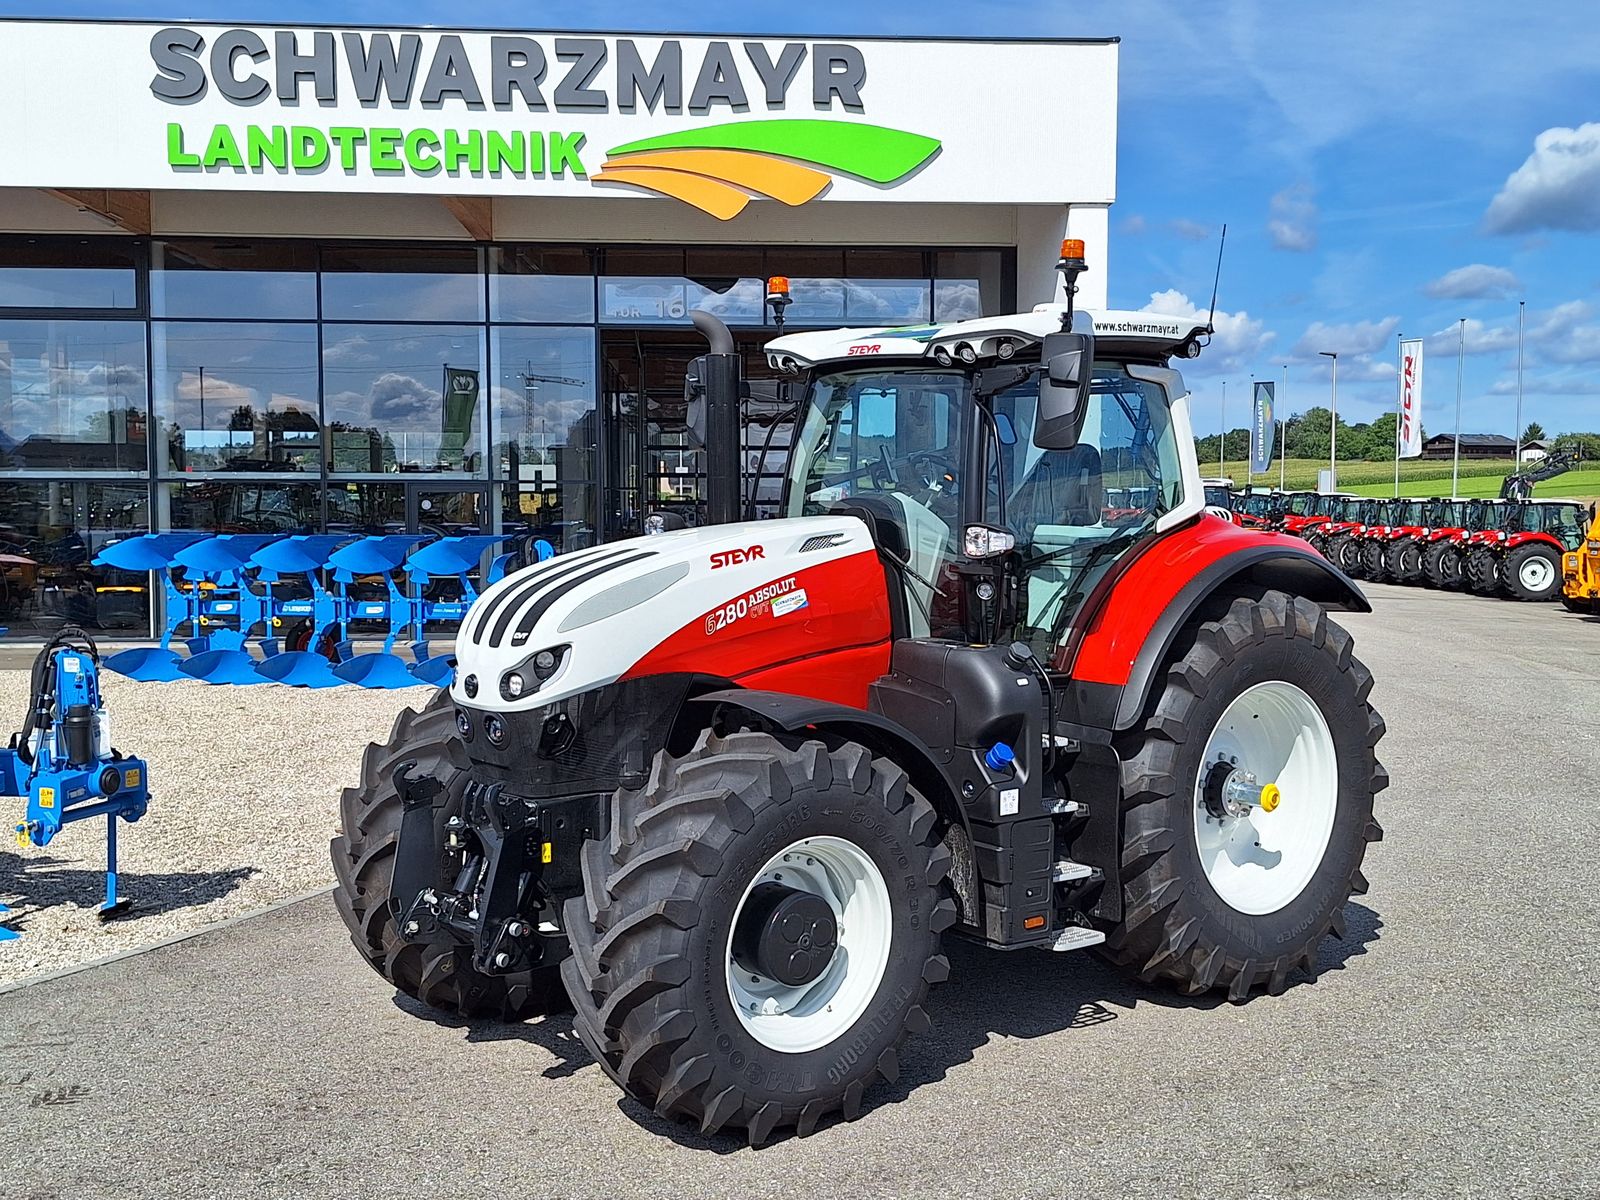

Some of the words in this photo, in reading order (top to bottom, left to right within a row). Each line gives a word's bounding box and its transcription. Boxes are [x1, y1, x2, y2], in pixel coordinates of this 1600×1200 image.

[150, 28, 866, 113] SCHWARZMAYR
[167, 123, 587, 177] LANDTECHNIK
[1094, 322, 1179, 335] www.schwarzmayr.at
[848, 344, 881, 356] STEYR
[710, 544, 766, 570] STEYR
[705, 598, 748, 635] 6280
[748, 577, 797, 608] ABSOLUT
